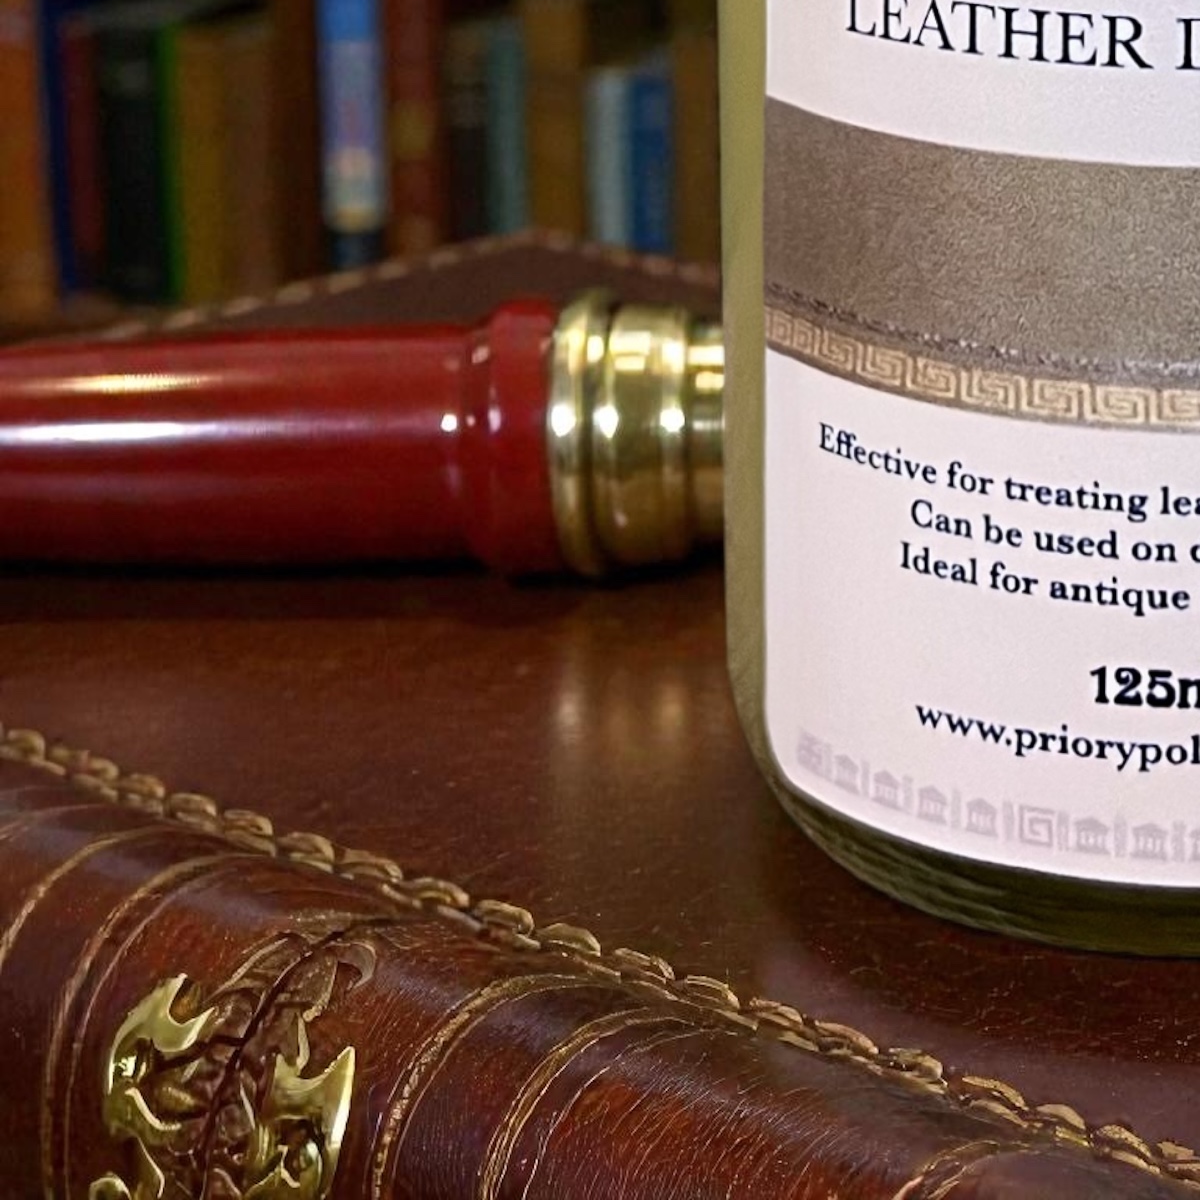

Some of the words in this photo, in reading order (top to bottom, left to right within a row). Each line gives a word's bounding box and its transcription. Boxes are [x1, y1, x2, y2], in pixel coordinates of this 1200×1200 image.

[818, 421, 938, 485] Effective
[946, 460, 994, 496] for
[1003, 476, 1149, 523] treating
[909, 498, 973, 540] Can
[982, 512, 1024, 549] be
[1032, 528, 1120, 561] used
[1130, 541, 1178, 564] on
[898, 540, 979, 587] Ideal
[988, 560, 1039, 596] for
[1048, 575, 1191, 618] antique
